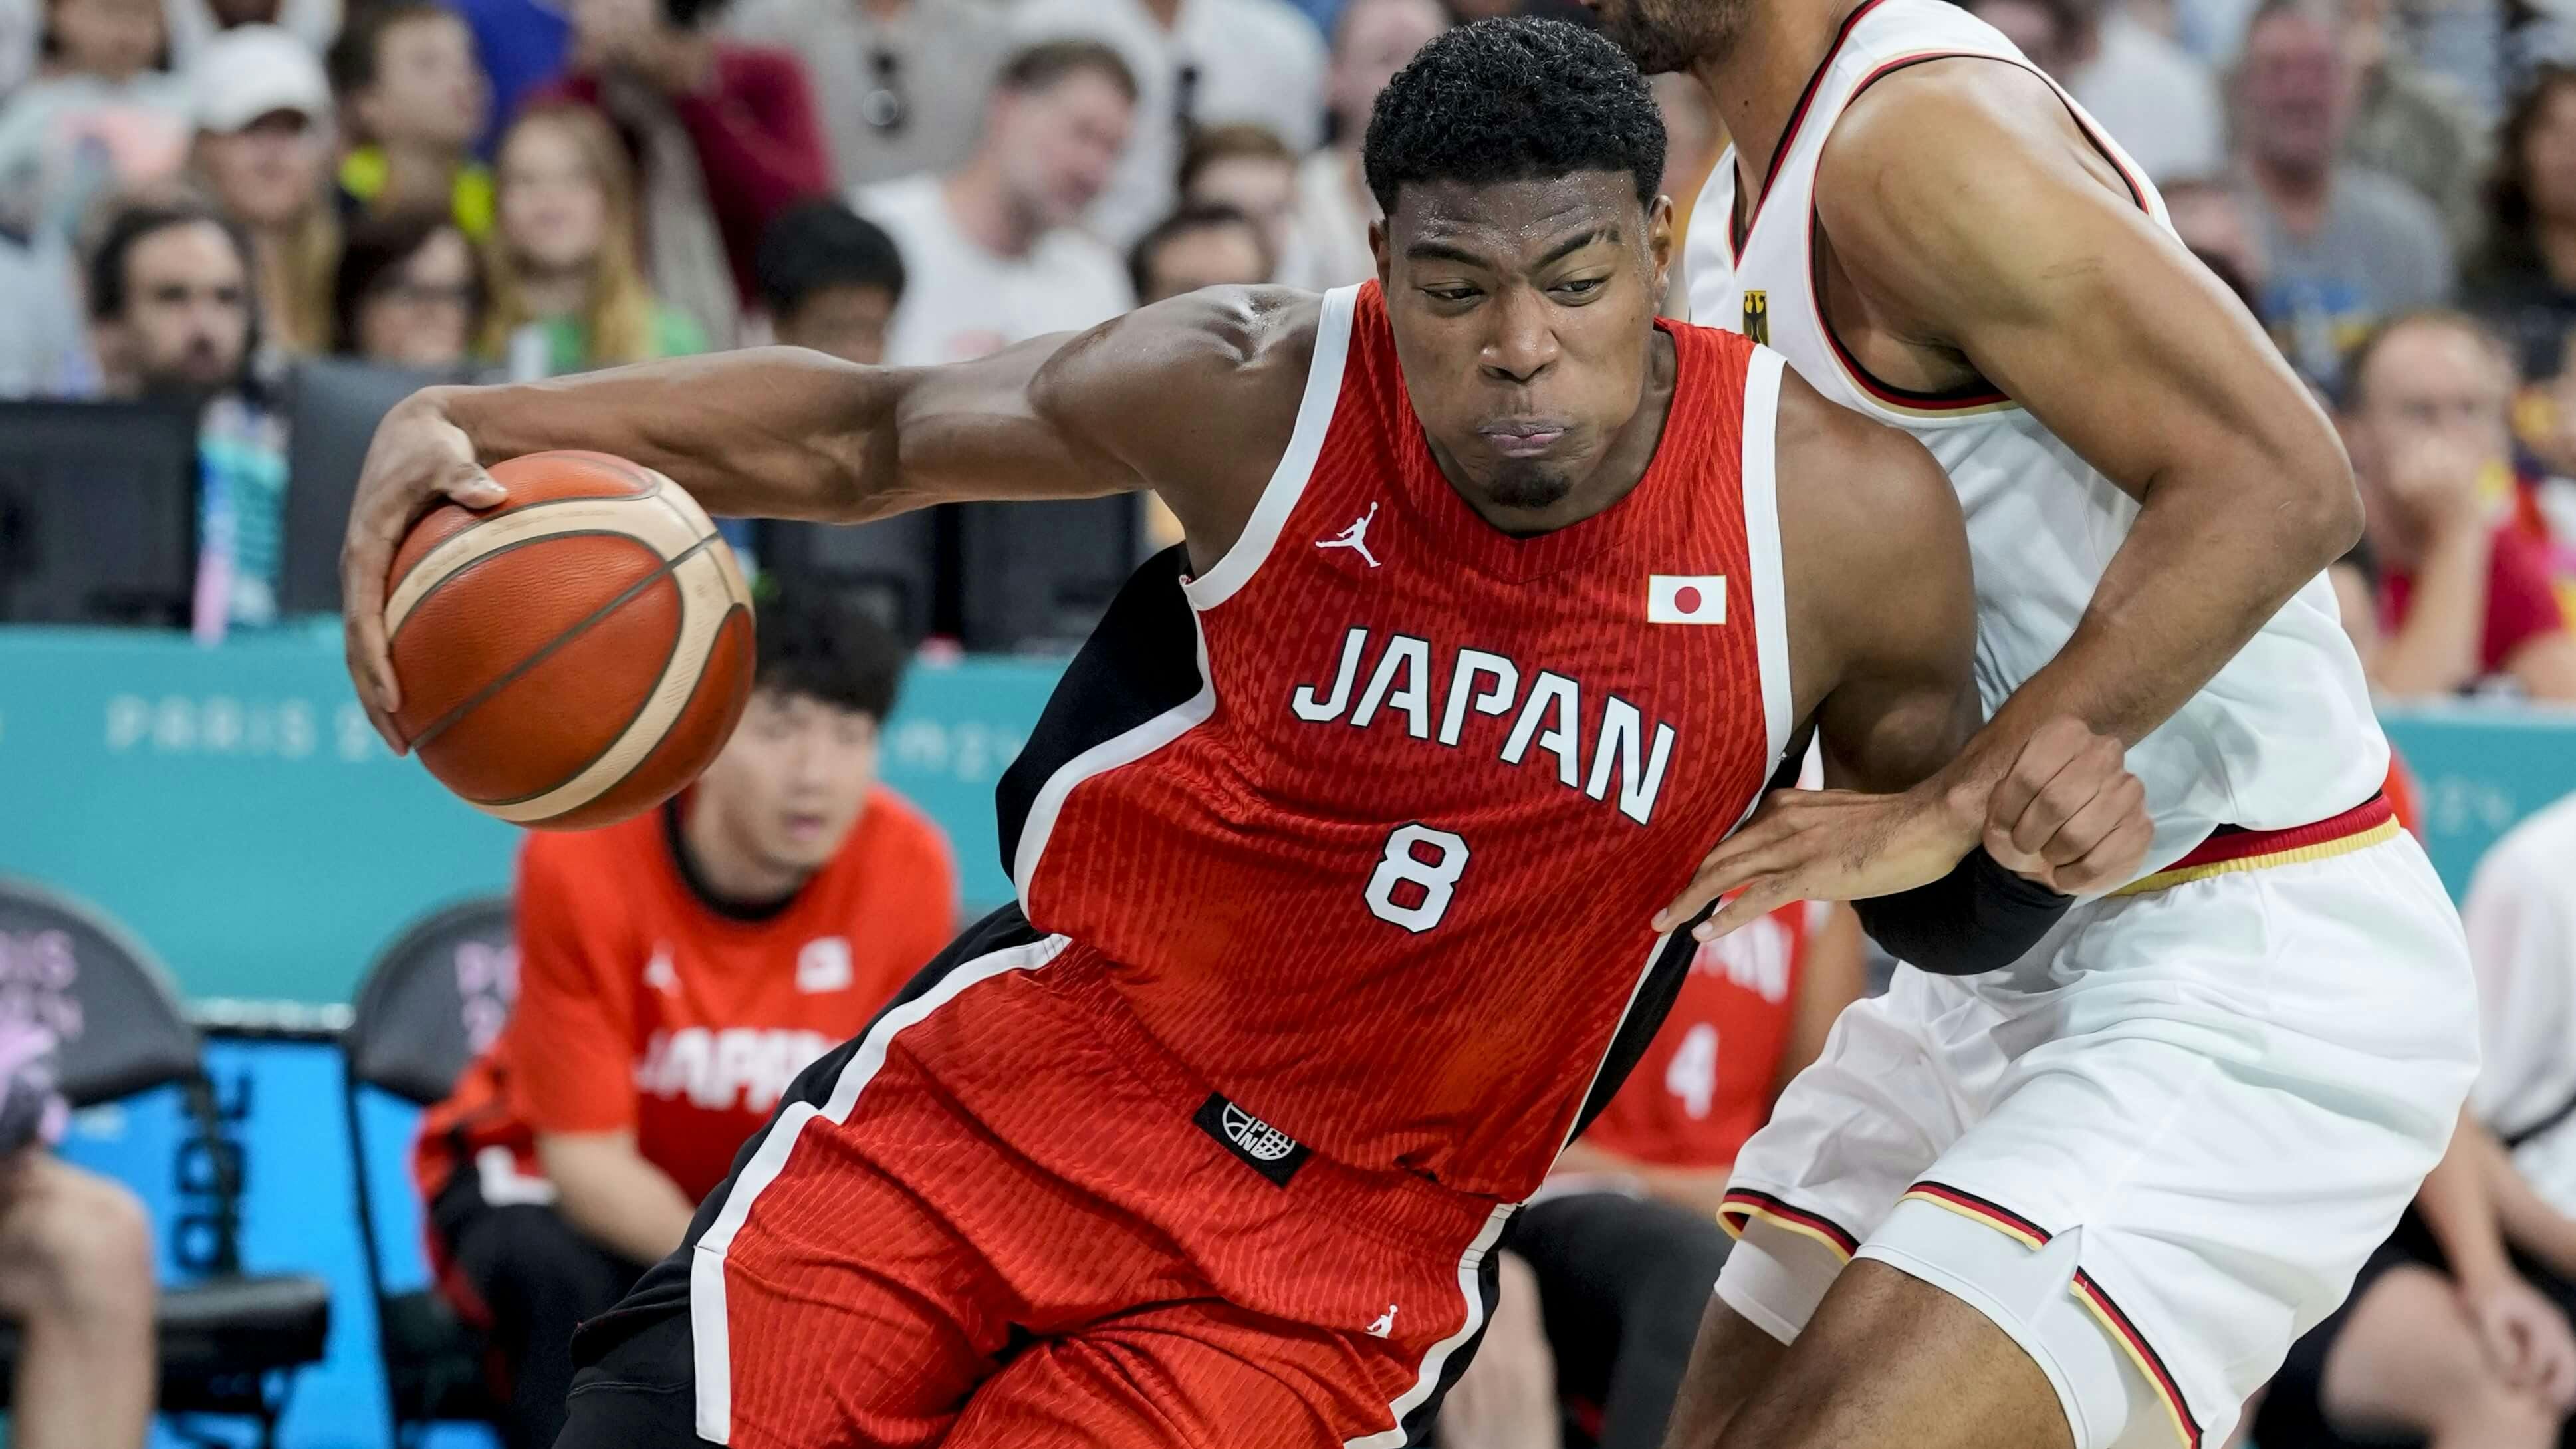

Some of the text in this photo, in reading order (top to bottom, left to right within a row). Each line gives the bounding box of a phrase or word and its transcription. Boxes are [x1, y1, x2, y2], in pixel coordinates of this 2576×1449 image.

[1292, 627, 1675, 825] JAPAN
[1364, 823, 1470, 933] 8
[1666, 1022, 1720, 1120] 4
